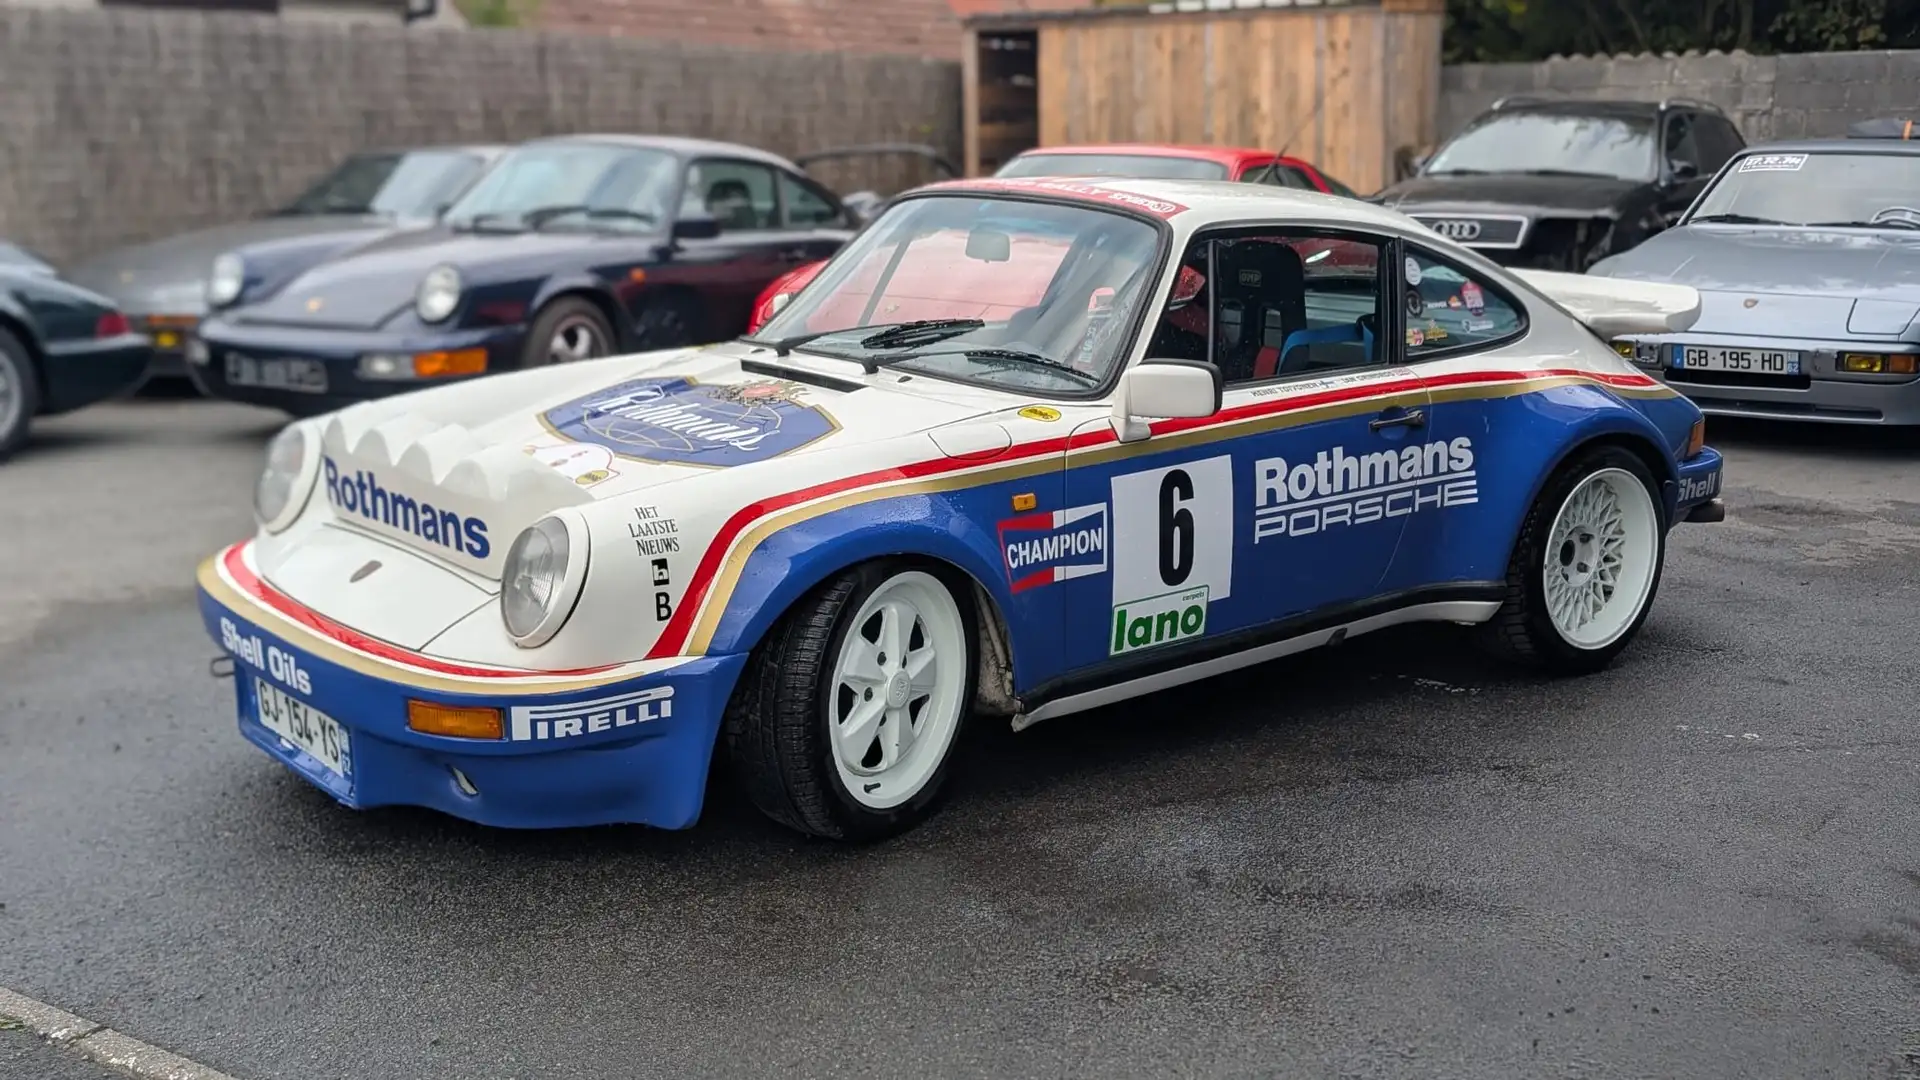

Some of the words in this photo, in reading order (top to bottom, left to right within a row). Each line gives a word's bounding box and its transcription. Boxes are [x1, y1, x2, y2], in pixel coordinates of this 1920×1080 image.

[1686, 348, 1784, 371] GB-195-HD
[1255, 437, 1474, 507] Rothmans
[324, 456, 490, 559] Rothmans
[628, 519, 679, 538] LAATSTE
[634, 506, 660, 520] HET
[1158, 469, 1195, 586] 6
[1254, 480, 1478, 544] PORSCHE
[635, 537, 680, 556] NIEUWS
[1007, 527, 1102, 569] CHAMPION
[655, 592, 672, 621] B
[1112, 604, 1204, 652] lano
[220, 617, 265, 671] Shell
[268, 646, 312, 695] Oils
[259, 680, 339, 763] GJ-154-YS
[511, 685, 675, 741] PIRELLI
